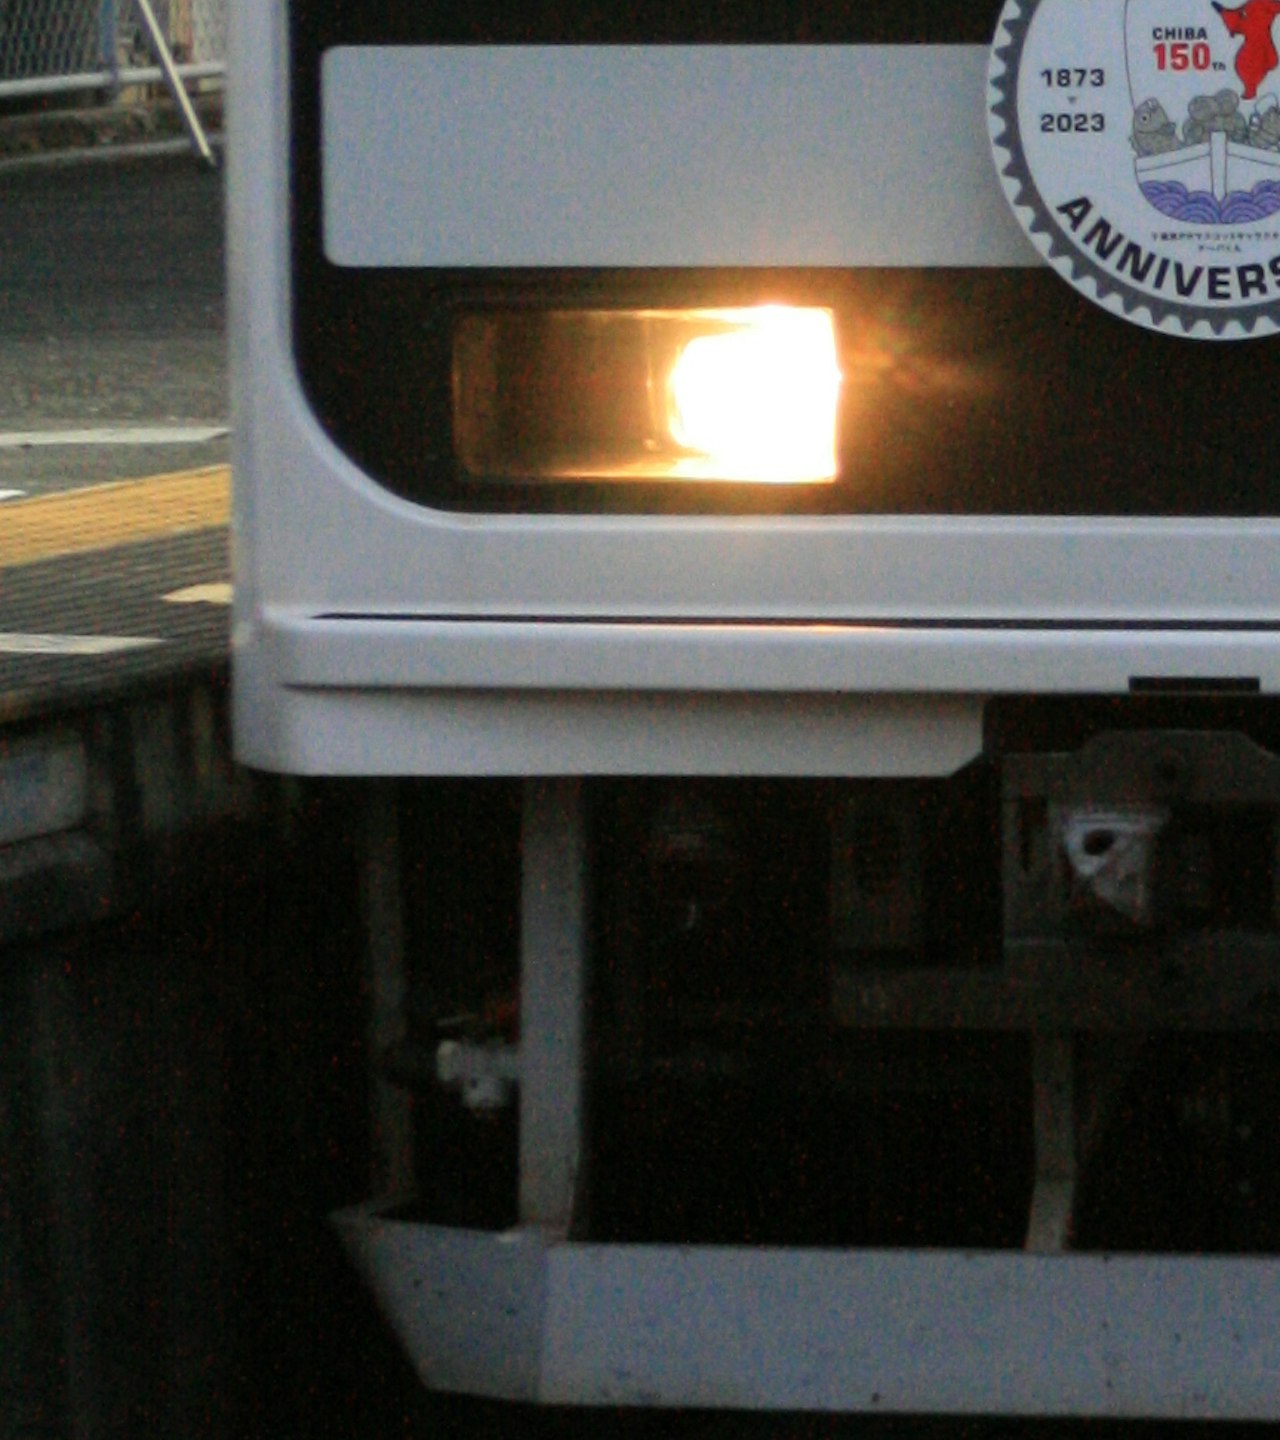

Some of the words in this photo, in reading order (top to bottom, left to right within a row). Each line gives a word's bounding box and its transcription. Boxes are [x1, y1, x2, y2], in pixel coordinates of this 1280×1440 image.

[1152, 27, 1208, 40] CHIBA
[1040, 69, 1105, 87] 1873
[1040, 114, 1105, 132] 2023
